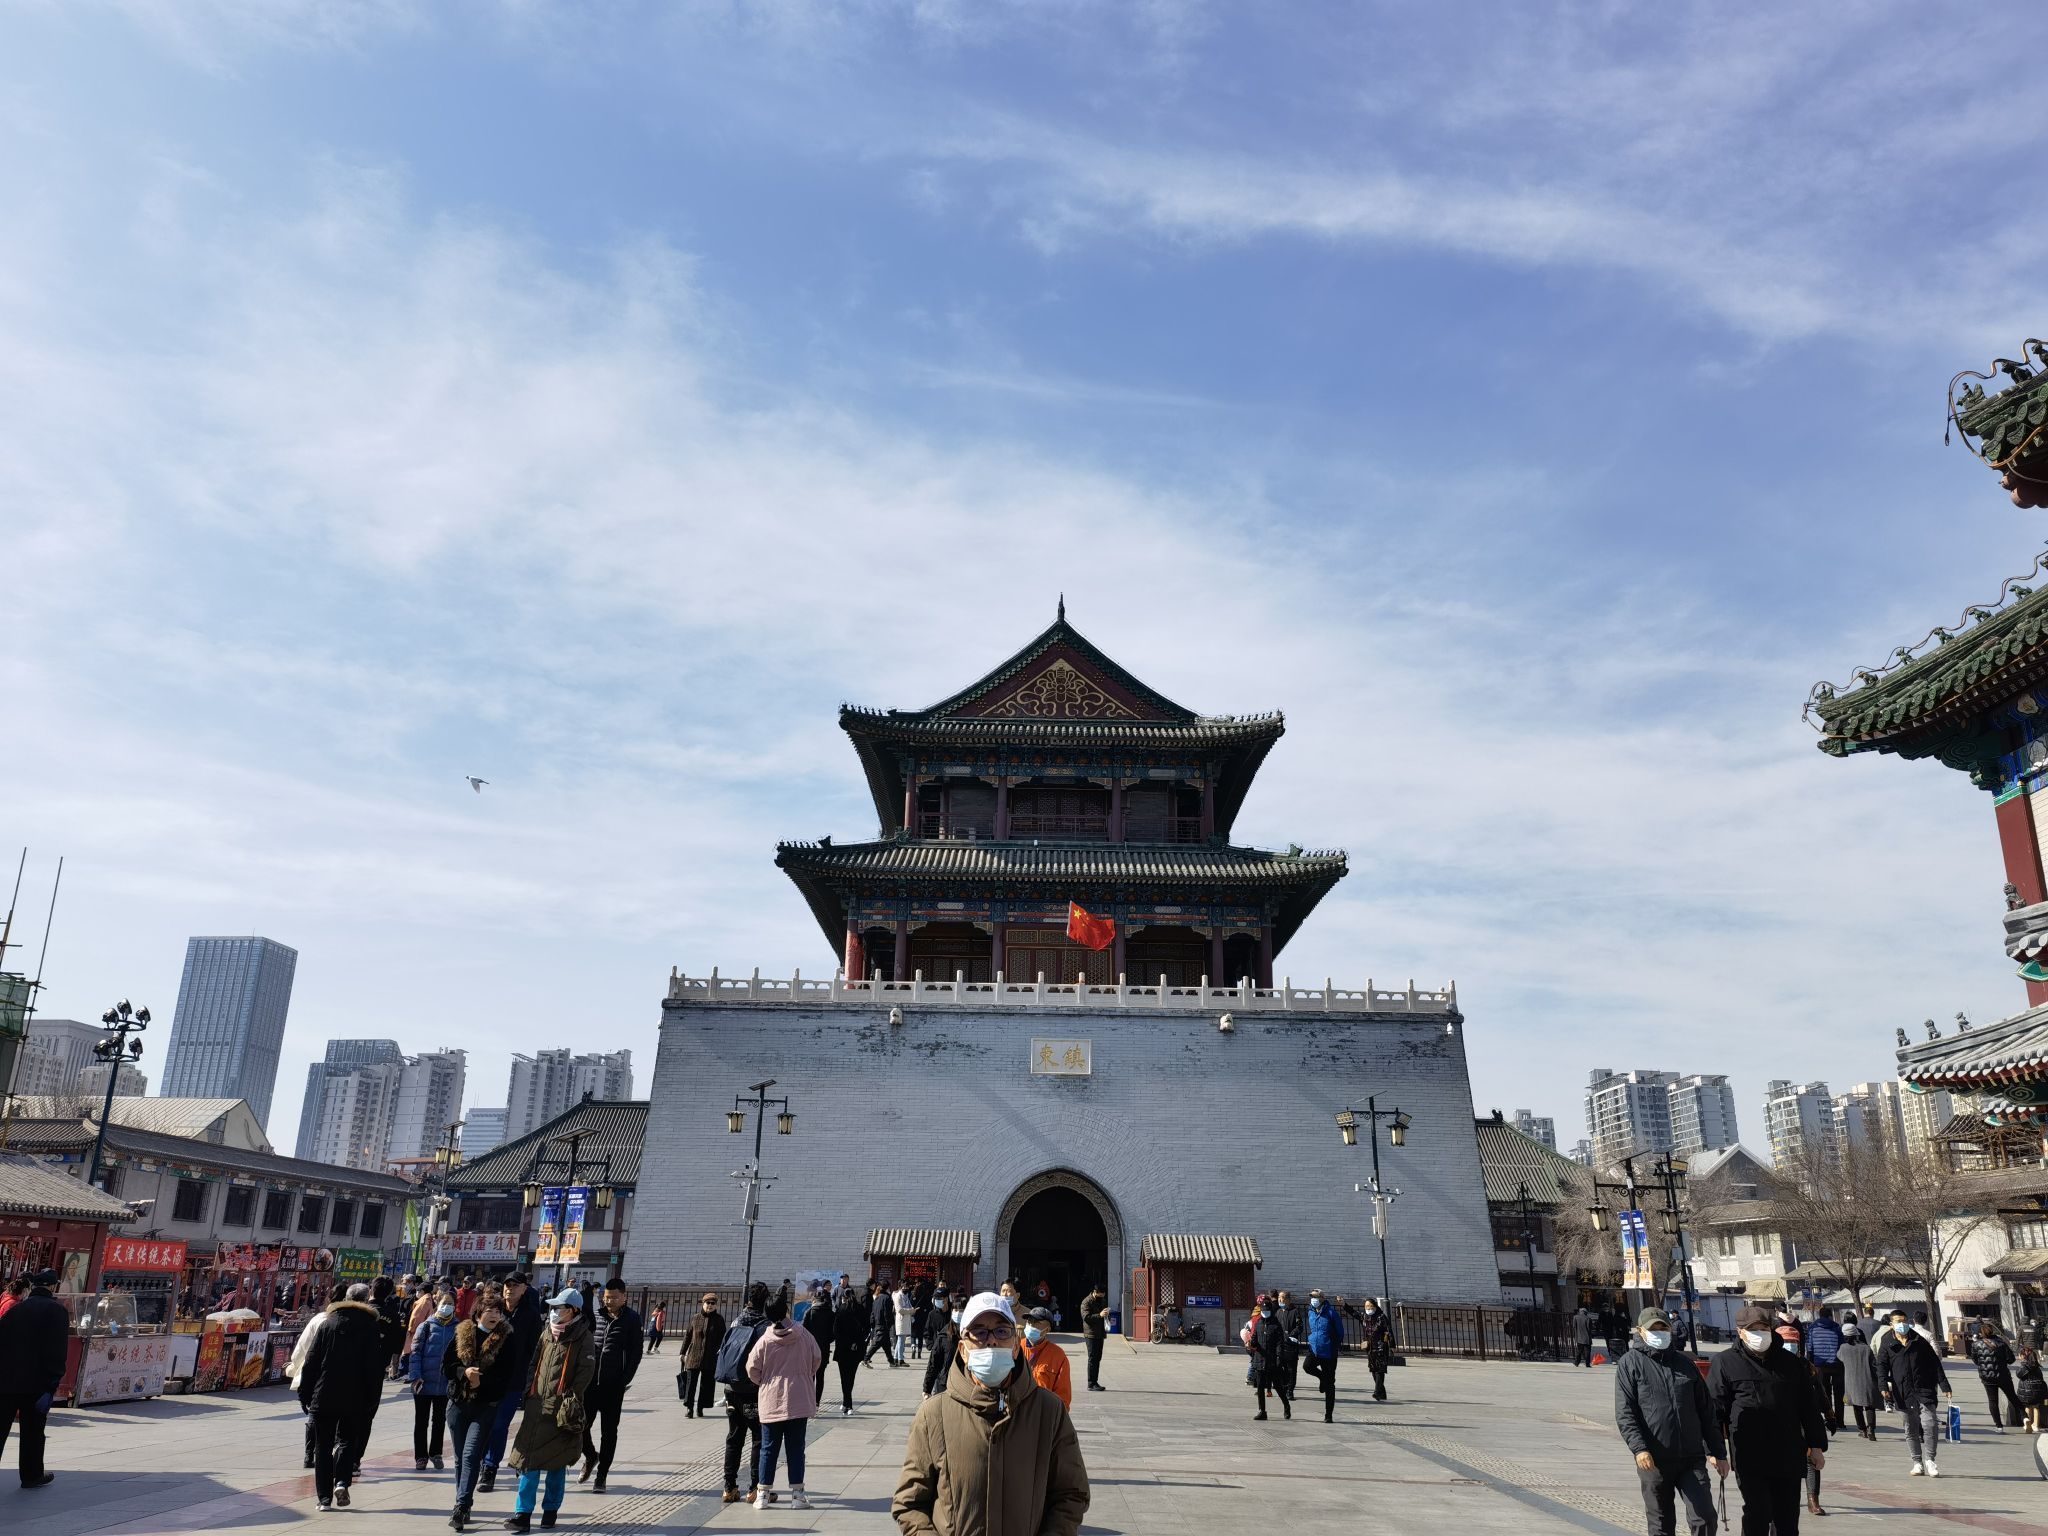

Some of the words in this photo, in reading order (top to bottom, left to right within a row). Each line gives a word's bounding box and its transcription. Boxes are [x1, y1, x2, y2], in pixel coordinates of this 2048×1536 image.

[112, 1244, 182, 1266] 天津传统茶汤
[116, 1343, 167, 1365] 传统茶汤
